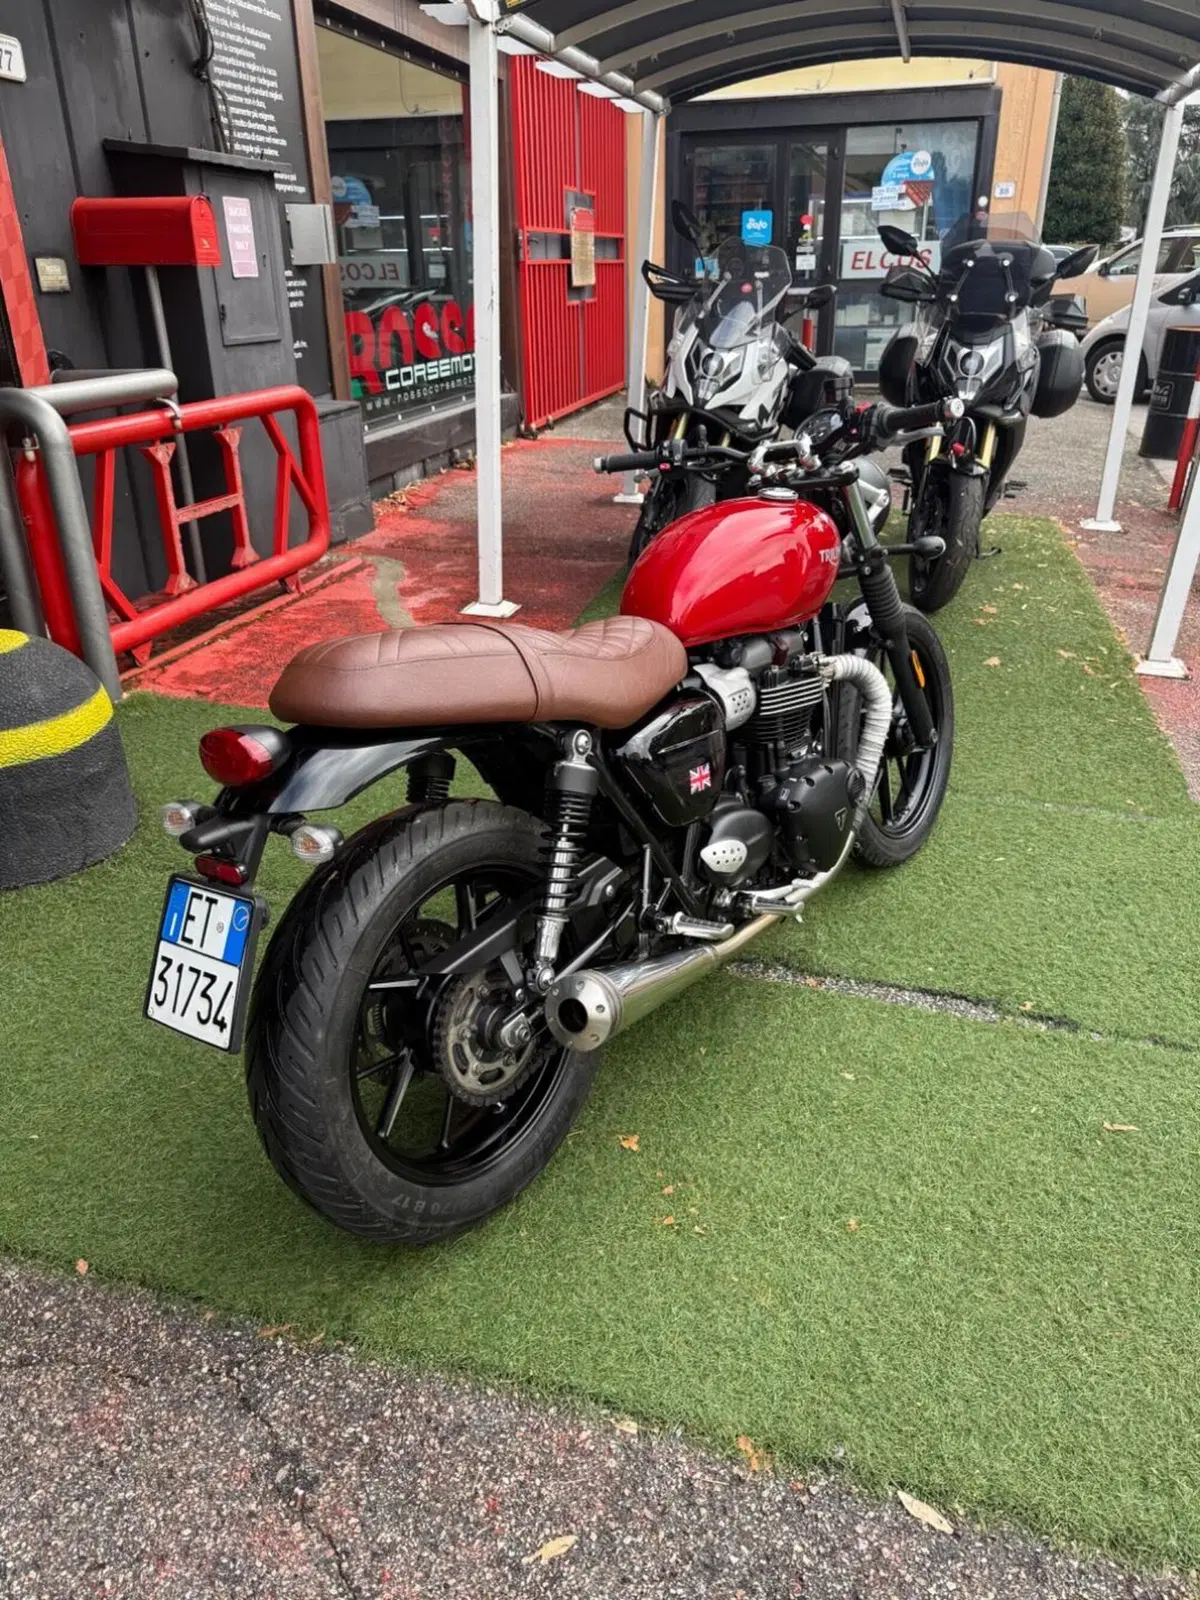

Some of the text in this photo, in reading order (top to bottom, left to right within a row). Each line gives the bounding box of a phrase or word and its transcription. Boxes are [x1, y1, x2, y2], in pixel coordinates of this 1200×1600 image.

[385, 353, 476, 390] CORSEMO
[180, 891, 219, 949] ET
[153, 955, 234, 1033] 31734
